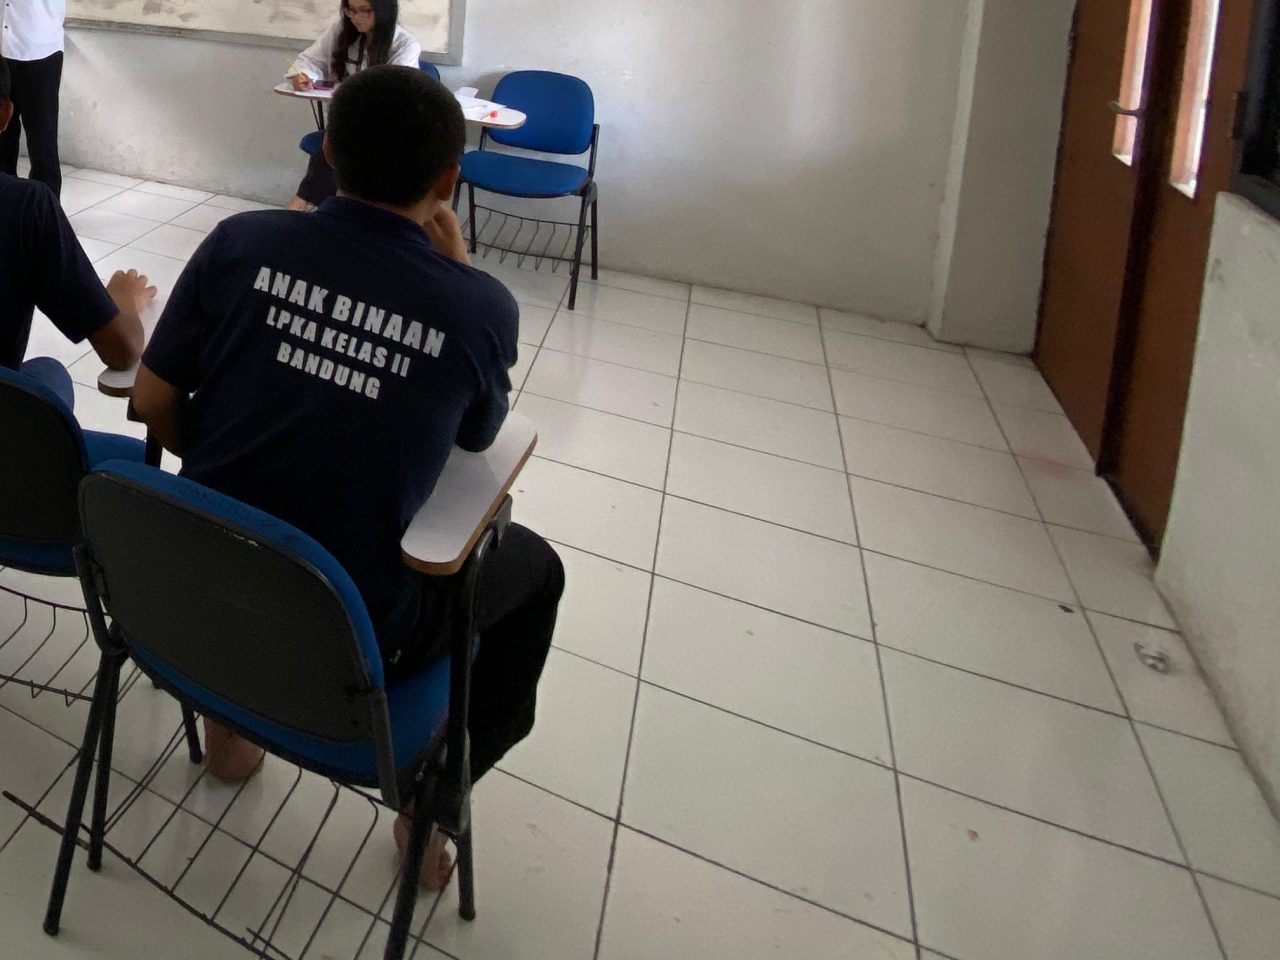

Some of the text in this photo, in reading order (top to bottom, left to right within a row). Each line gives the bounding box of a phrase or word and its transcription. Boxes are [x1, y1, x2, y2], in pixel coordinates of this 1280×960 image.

[253, 266, 445, 357] ANAK BINAAN
[266, 305, 411, 377] LPKA KELAS II
[276, 342, 381, 399] BANDUNG
